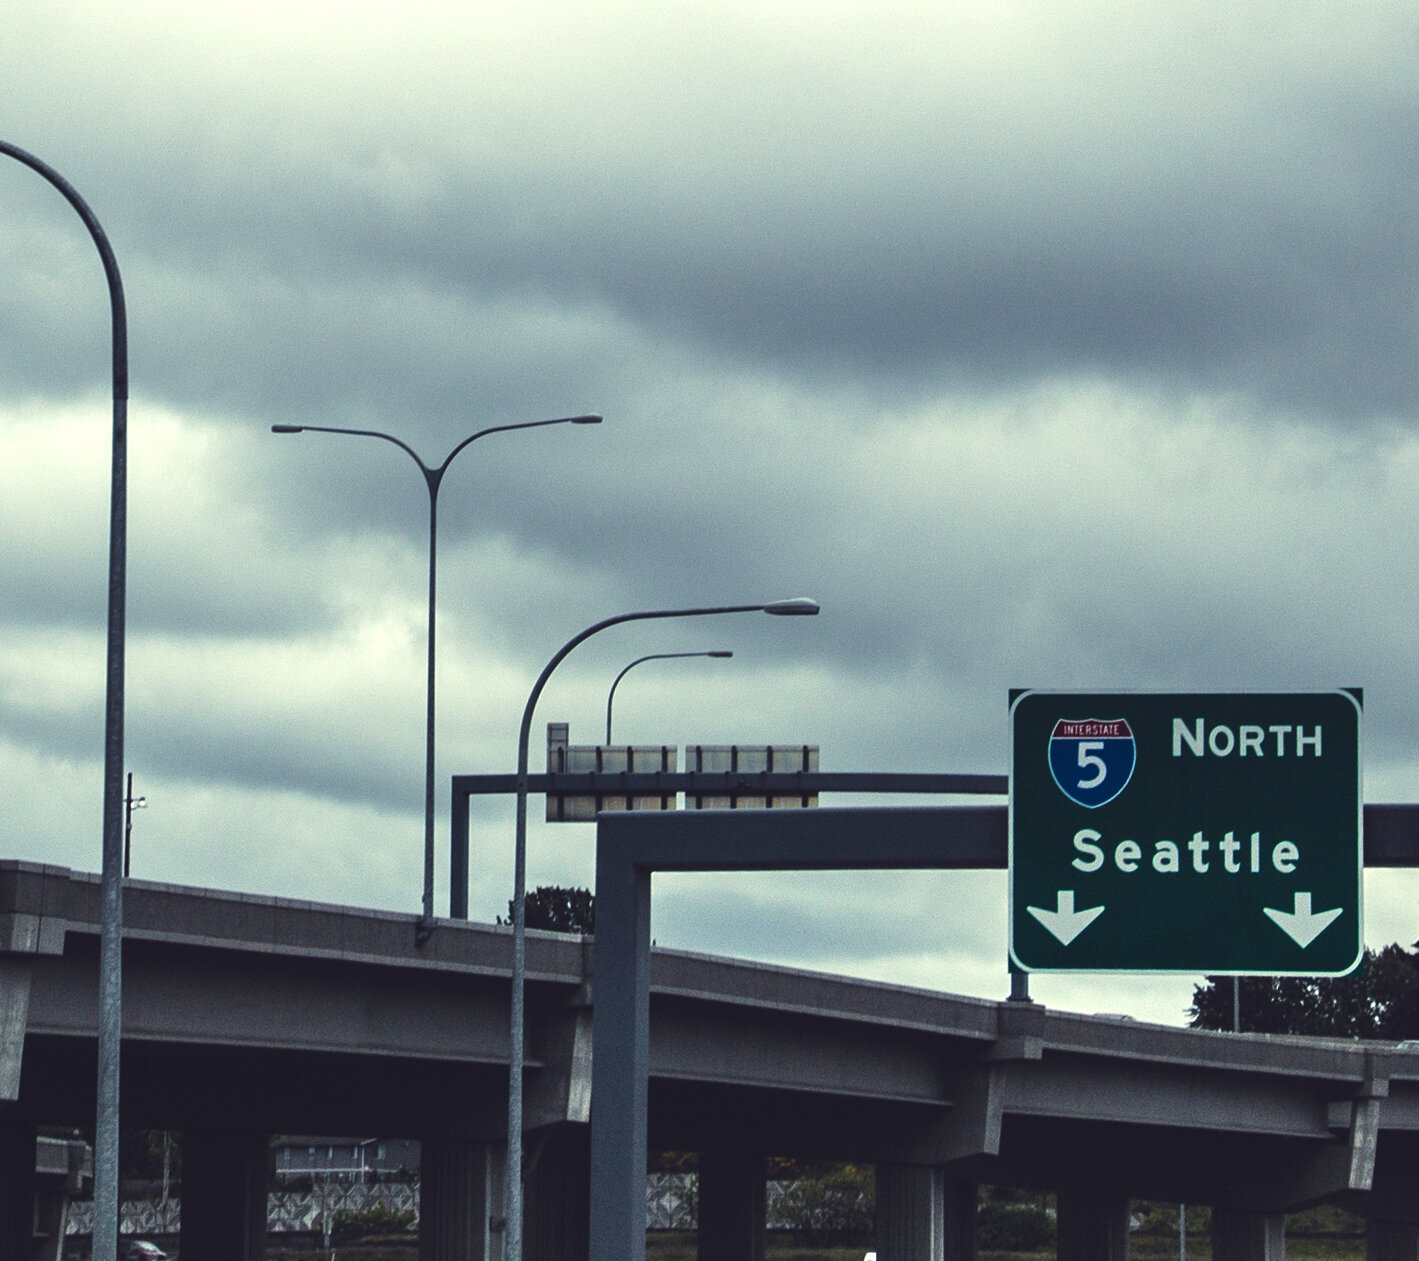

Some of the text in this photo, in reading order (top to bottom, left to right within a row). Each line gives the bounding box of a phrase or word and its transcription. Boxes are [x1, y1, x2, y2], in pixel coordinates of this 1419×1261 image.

[1063, 724, 1120, 736] INTERSTATE
[1077, 741, 1107, 789] 5
[1071, 828, 1300, 874] Seattle
